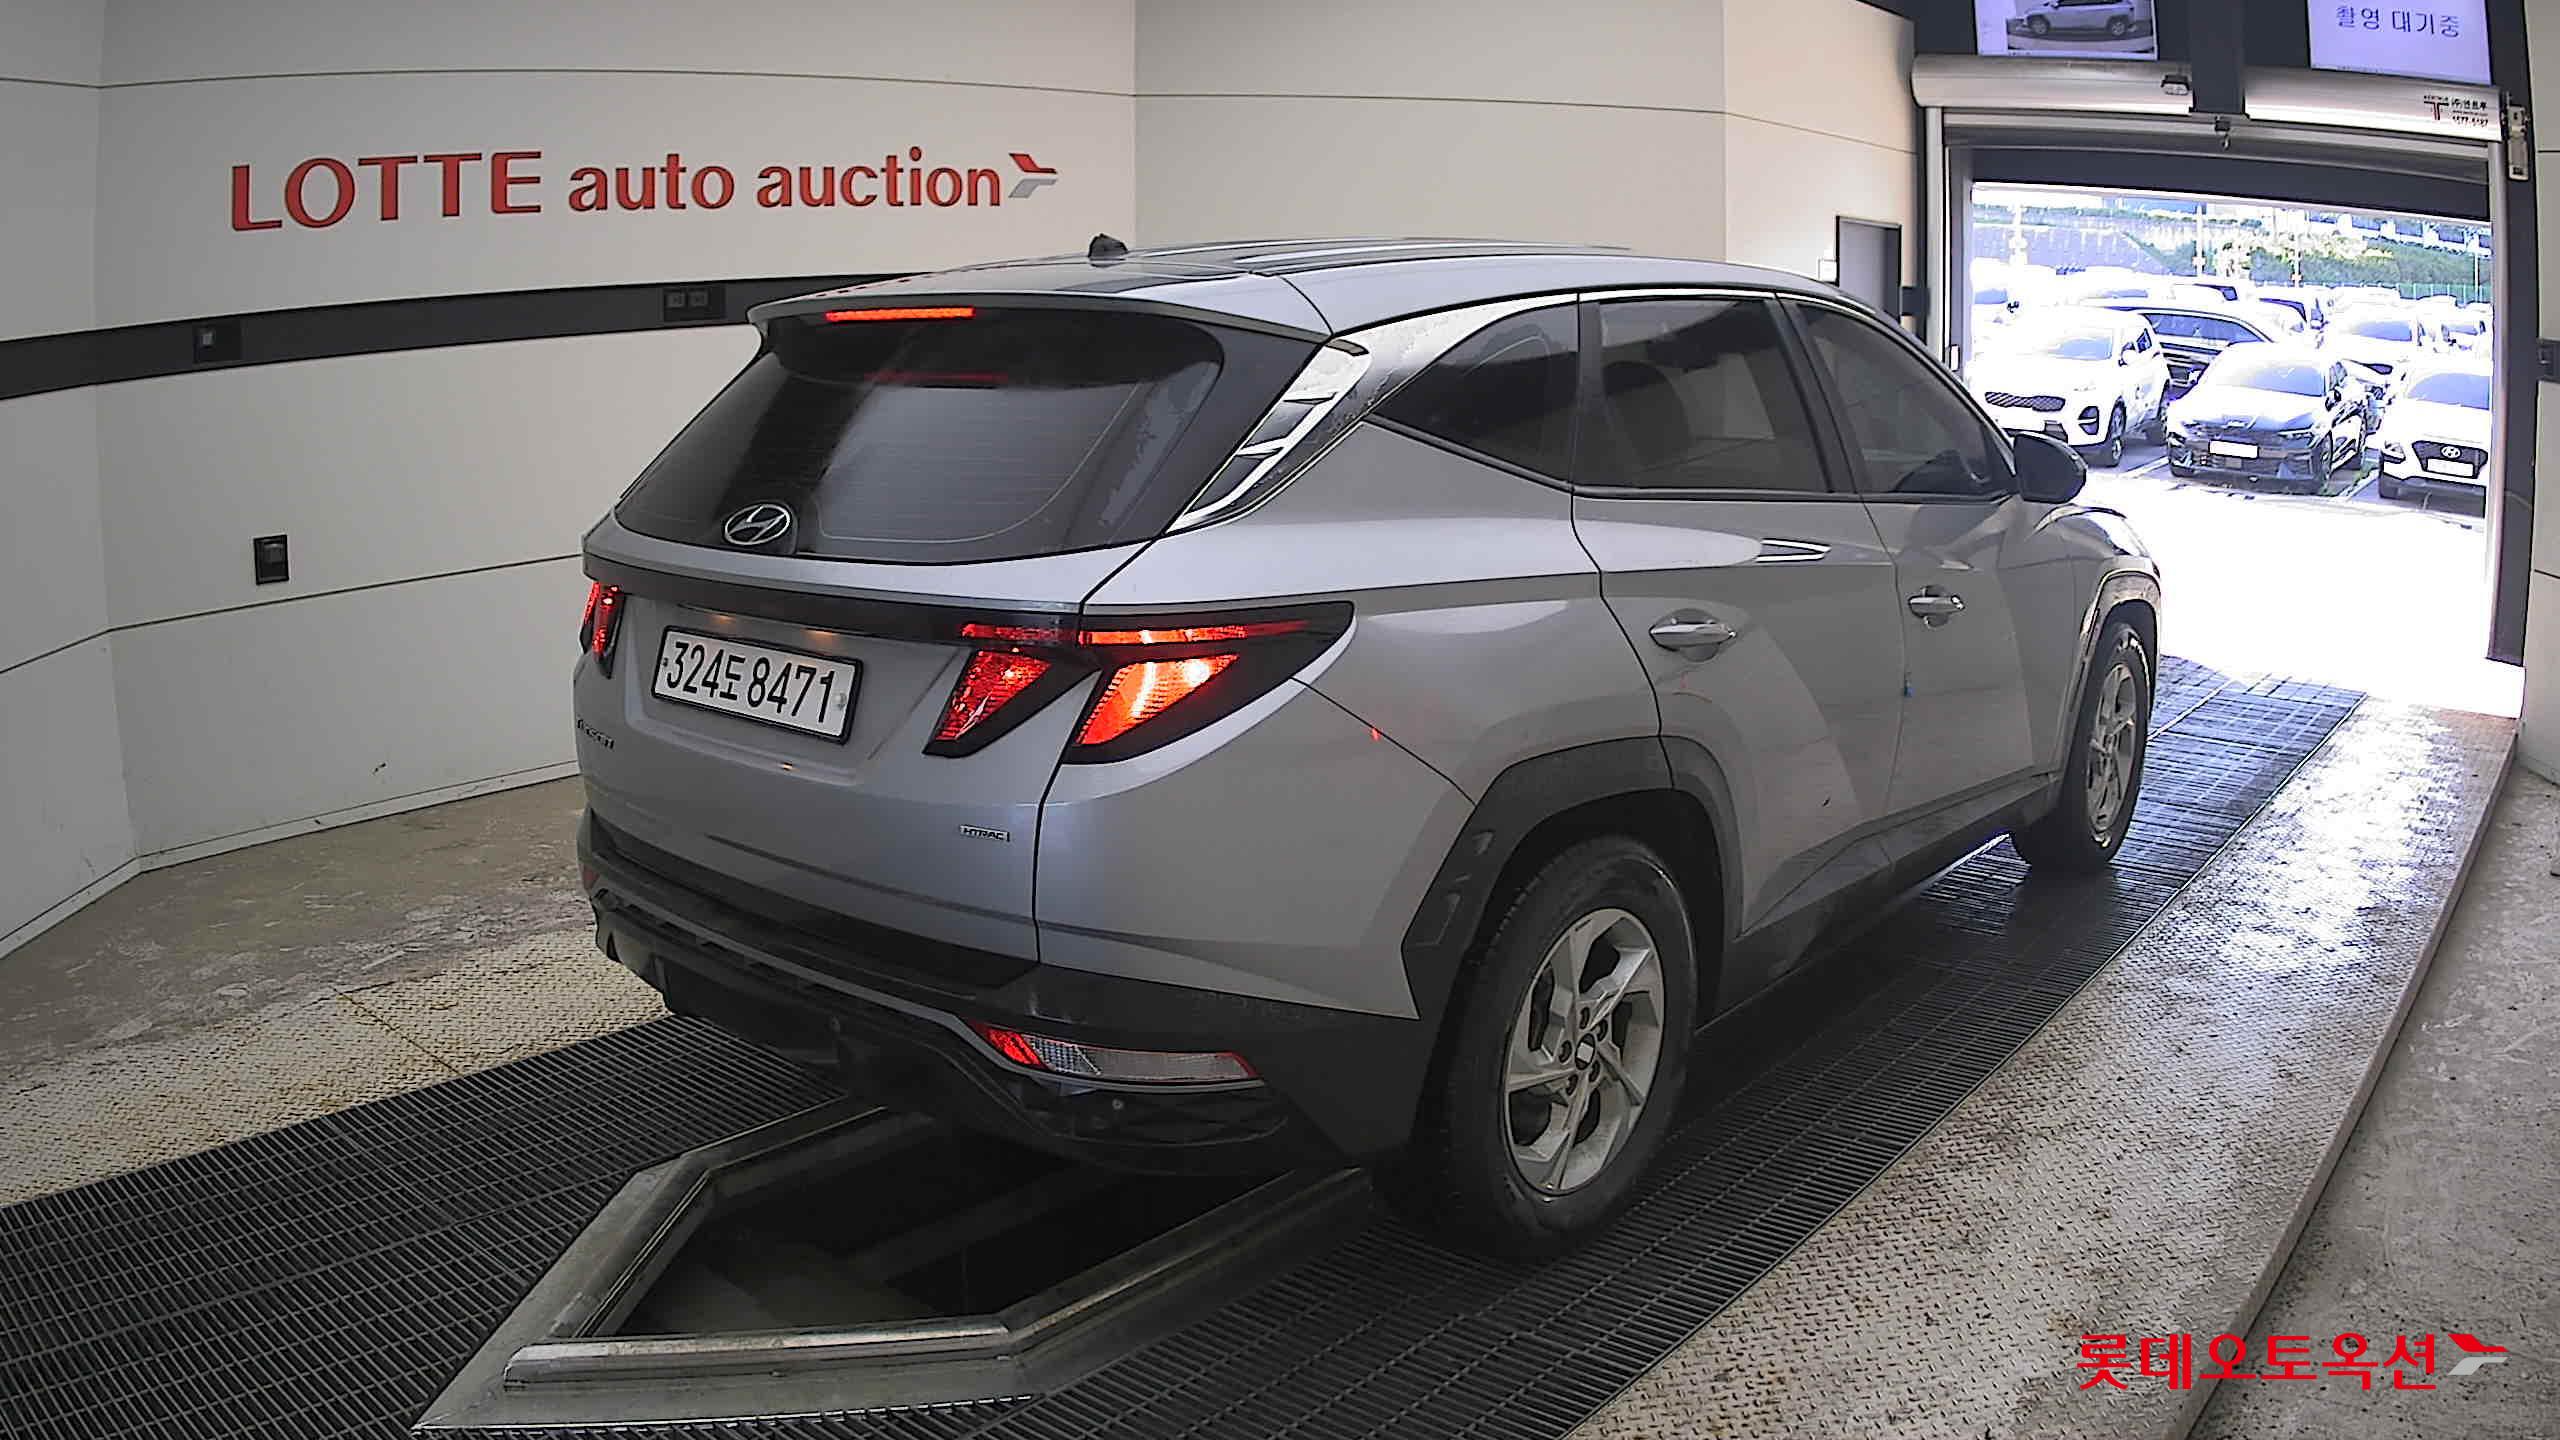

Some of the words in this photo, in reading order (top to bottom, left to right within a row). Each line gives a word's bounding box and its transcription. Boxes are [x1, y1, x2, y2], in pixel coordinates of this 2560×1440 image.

[2336, 6, 2381, 31] 촬영
[2392, 10, 2460, 38] 대기중
[231, 150, 541, 232] LOTTE
[568, 152, 736, 210] auto
[756, 146, 1002, 208] auction
[747, 656, 836, 723] 8471
